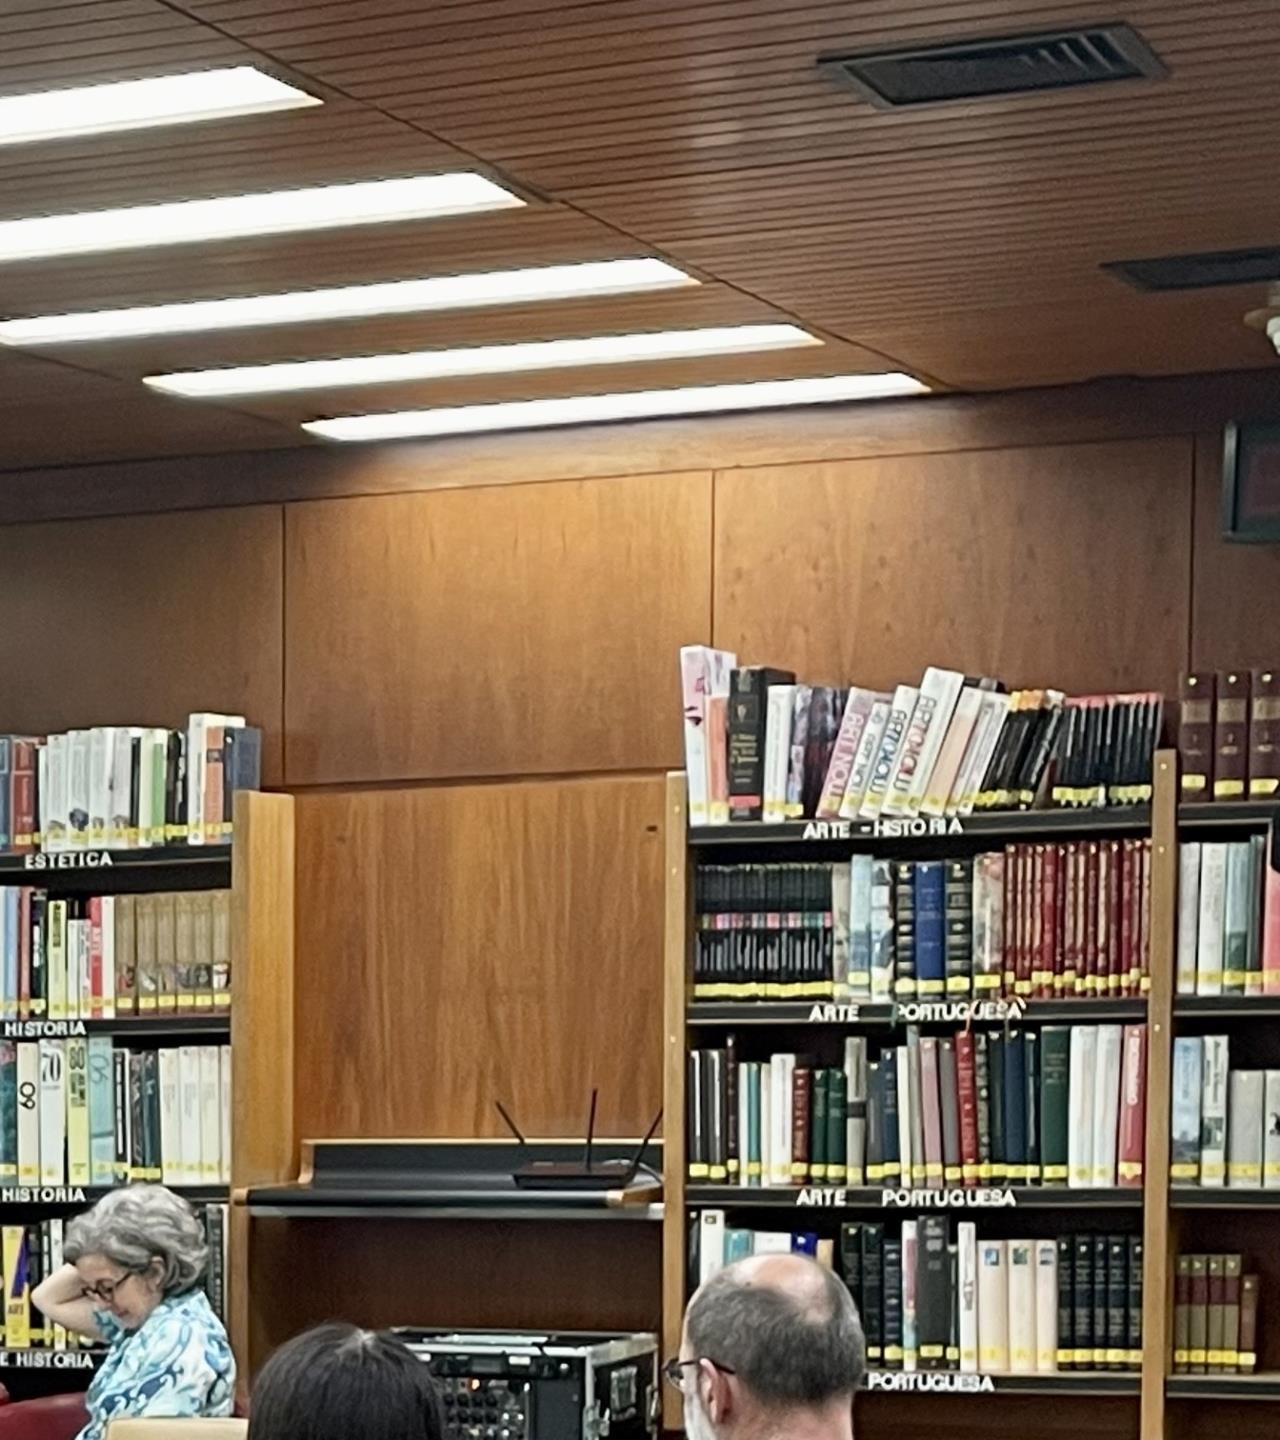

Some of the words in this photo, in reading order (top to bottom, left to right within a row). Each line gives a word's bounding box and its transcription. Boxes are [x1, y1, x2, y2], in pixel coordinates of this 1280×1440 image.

[803, 822, 851, 840] ARTE
[25, 851, 113, 870] ESTETICA
[809, 1004, 859, 1021] ARTE
[4, 1020, 87, 1037] HISTORIA
[41, 1052, 61, 1082] 70
[2, 1187, 86, 1202] HISTORIA
[797, 1189, 846, 1207] ARTE
[882, 1188, 1016, 1207] PORTUGUESA
[17, 1352, 94, 1369] HISTORIA
[868, 1373, 994, 1391] PORTUGUESA
